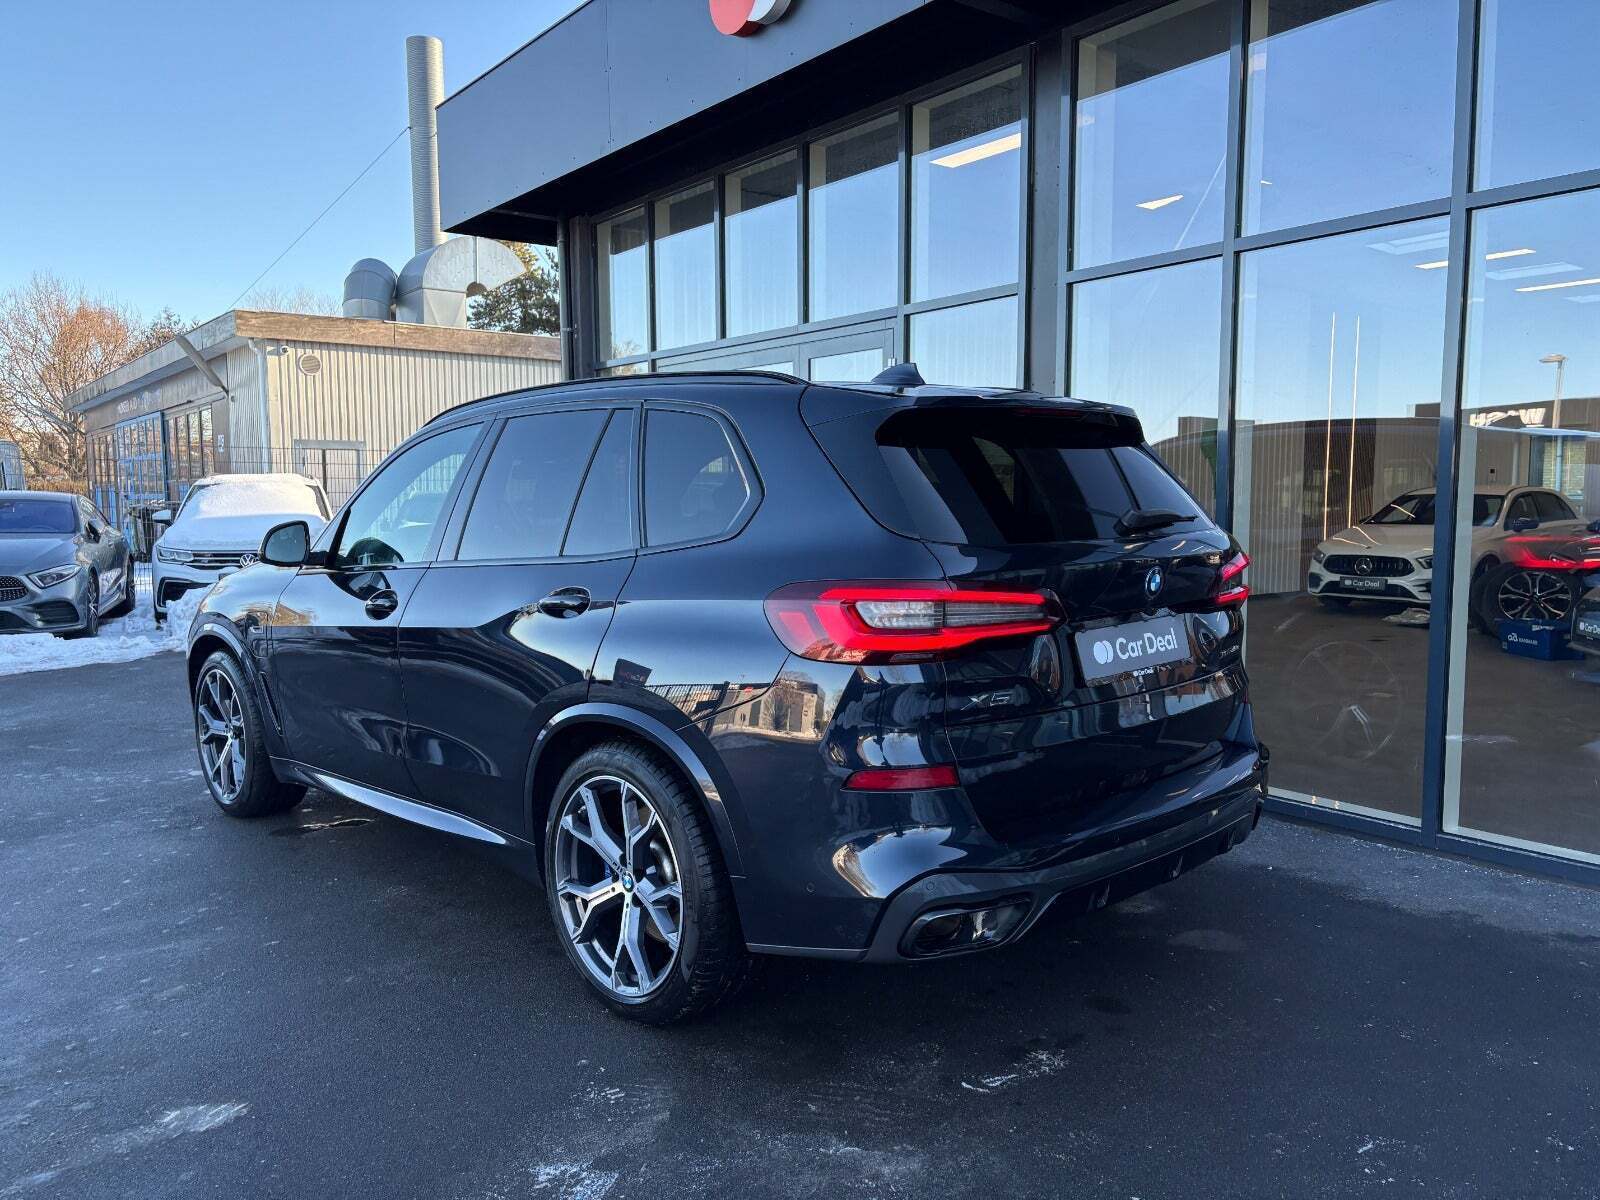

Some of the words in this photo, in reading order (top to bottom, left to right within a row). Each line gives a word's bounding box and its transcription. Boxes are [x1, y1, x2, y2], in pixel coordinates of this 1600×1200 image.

[1115, 637, 1143, 660] Car
[1143, 628, 1178, 654] Deal
[960, 691, 1010, 711] X5
